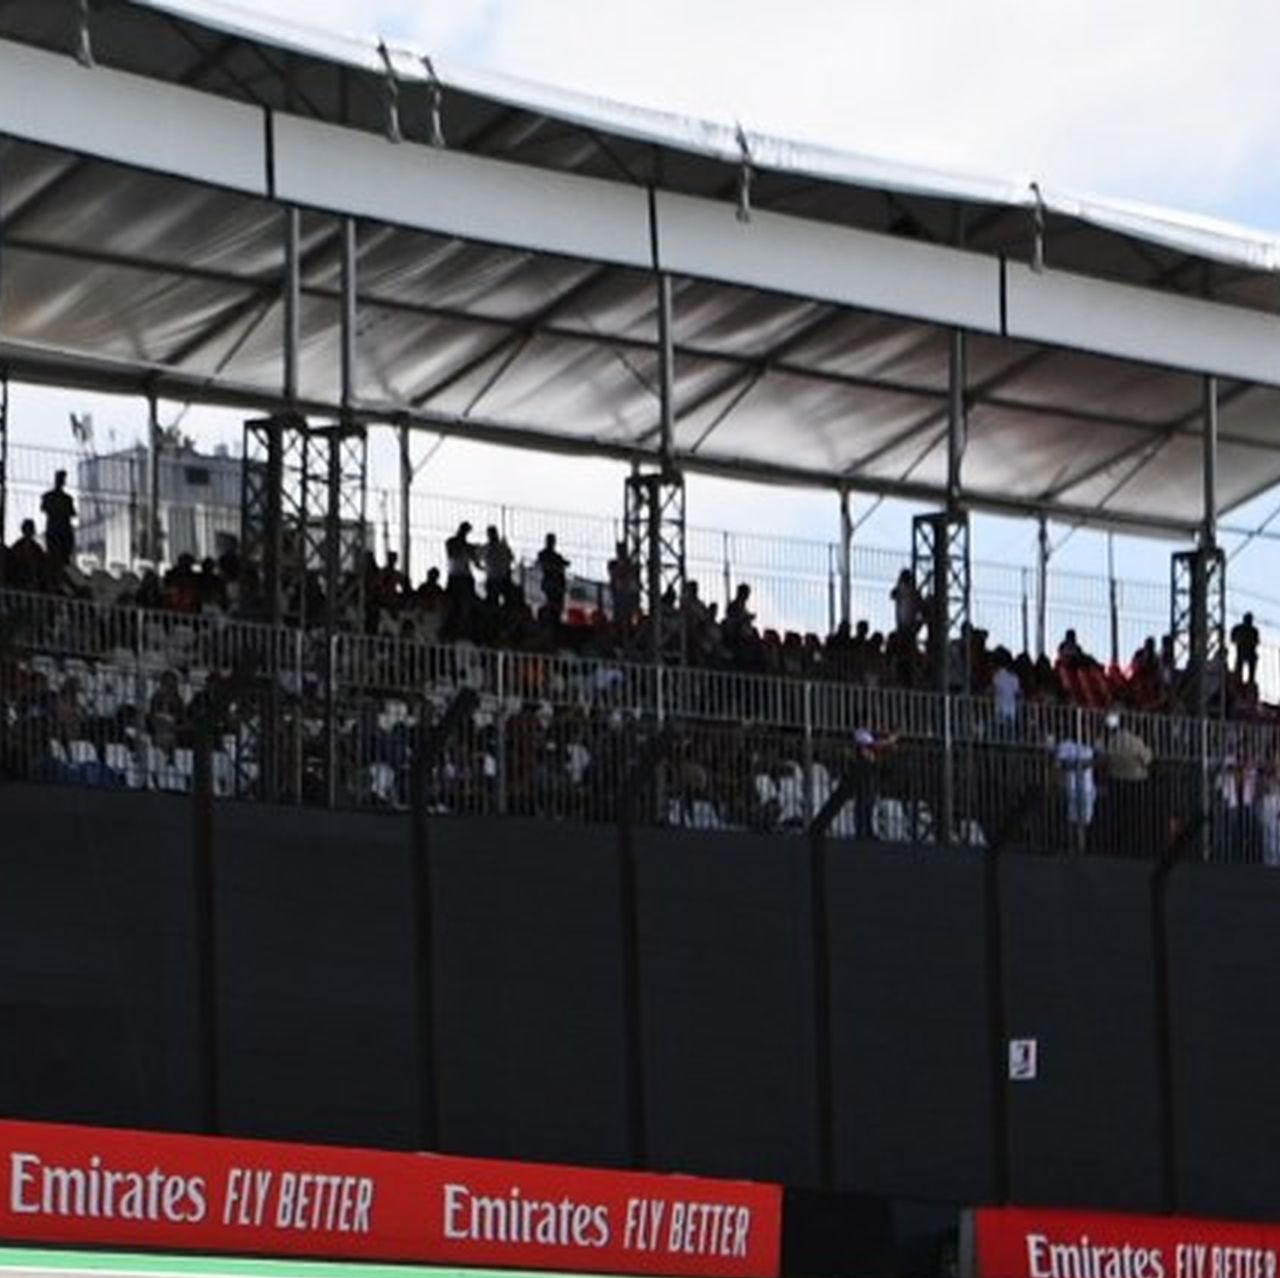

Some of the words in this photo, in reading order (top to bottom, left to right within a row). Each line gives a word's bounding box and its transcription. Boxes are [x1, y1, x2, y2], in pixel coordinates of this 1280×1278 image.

[10, 1152, 206, 1223] Emirates
[223, 1168, 272, 1227] FLY
[276, 1171, 374, 1233] BETTER
[443, 1184, 609, 1247] Emirates
[623, 1198, 665, 1251] FLY
[667, 1201, 751, 1258] BETTER
